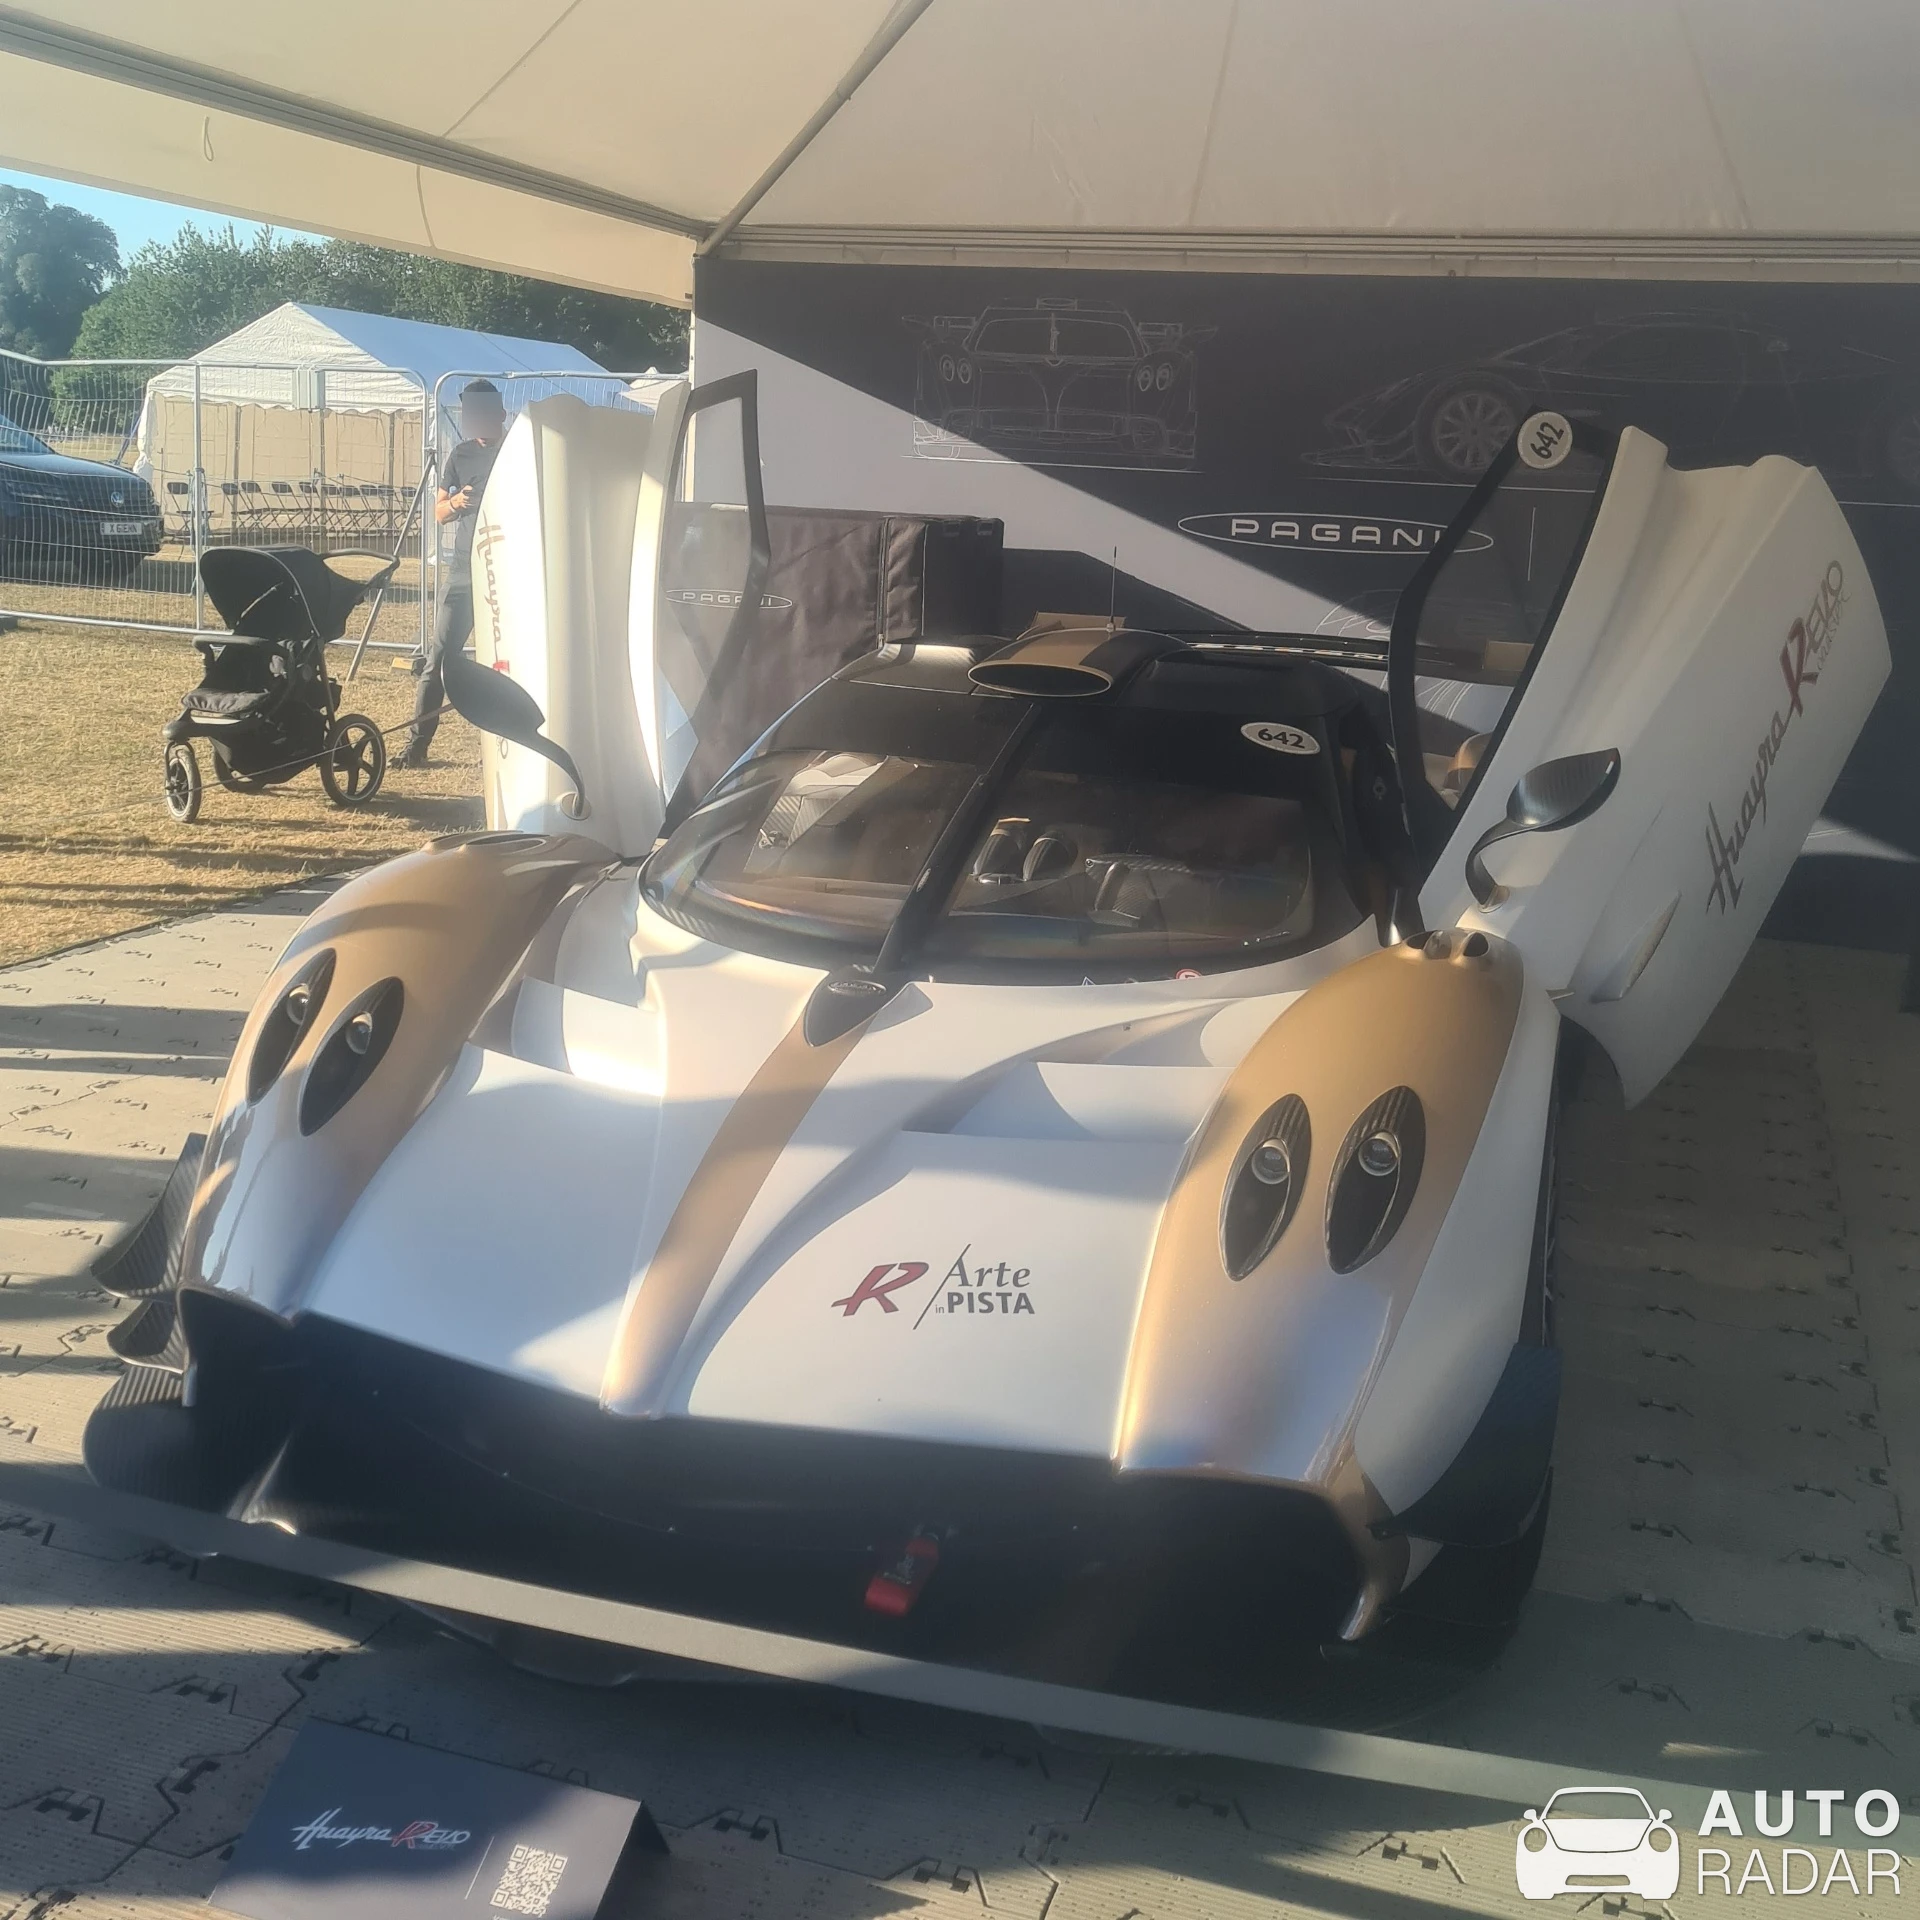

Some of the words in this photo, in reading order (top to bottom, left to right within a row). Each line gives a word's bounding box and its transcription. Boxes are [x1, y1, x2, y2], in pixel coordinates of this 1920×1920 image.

[1530, 422, 1564, 459] 642
[477, 510, 506, 663] Huayra
[682, 592, 772, 607] PAGAI
[1258, 728, 1306, 749] 642
[1705, 703, 1794, 916] Huayra
[948, 1250, 1031, 1288] Arte
[935, 1304, 945, 1314] in
[947, 1291, 1036, 1315] PISTA
[290, 1806, 393, 1851] Huayra
